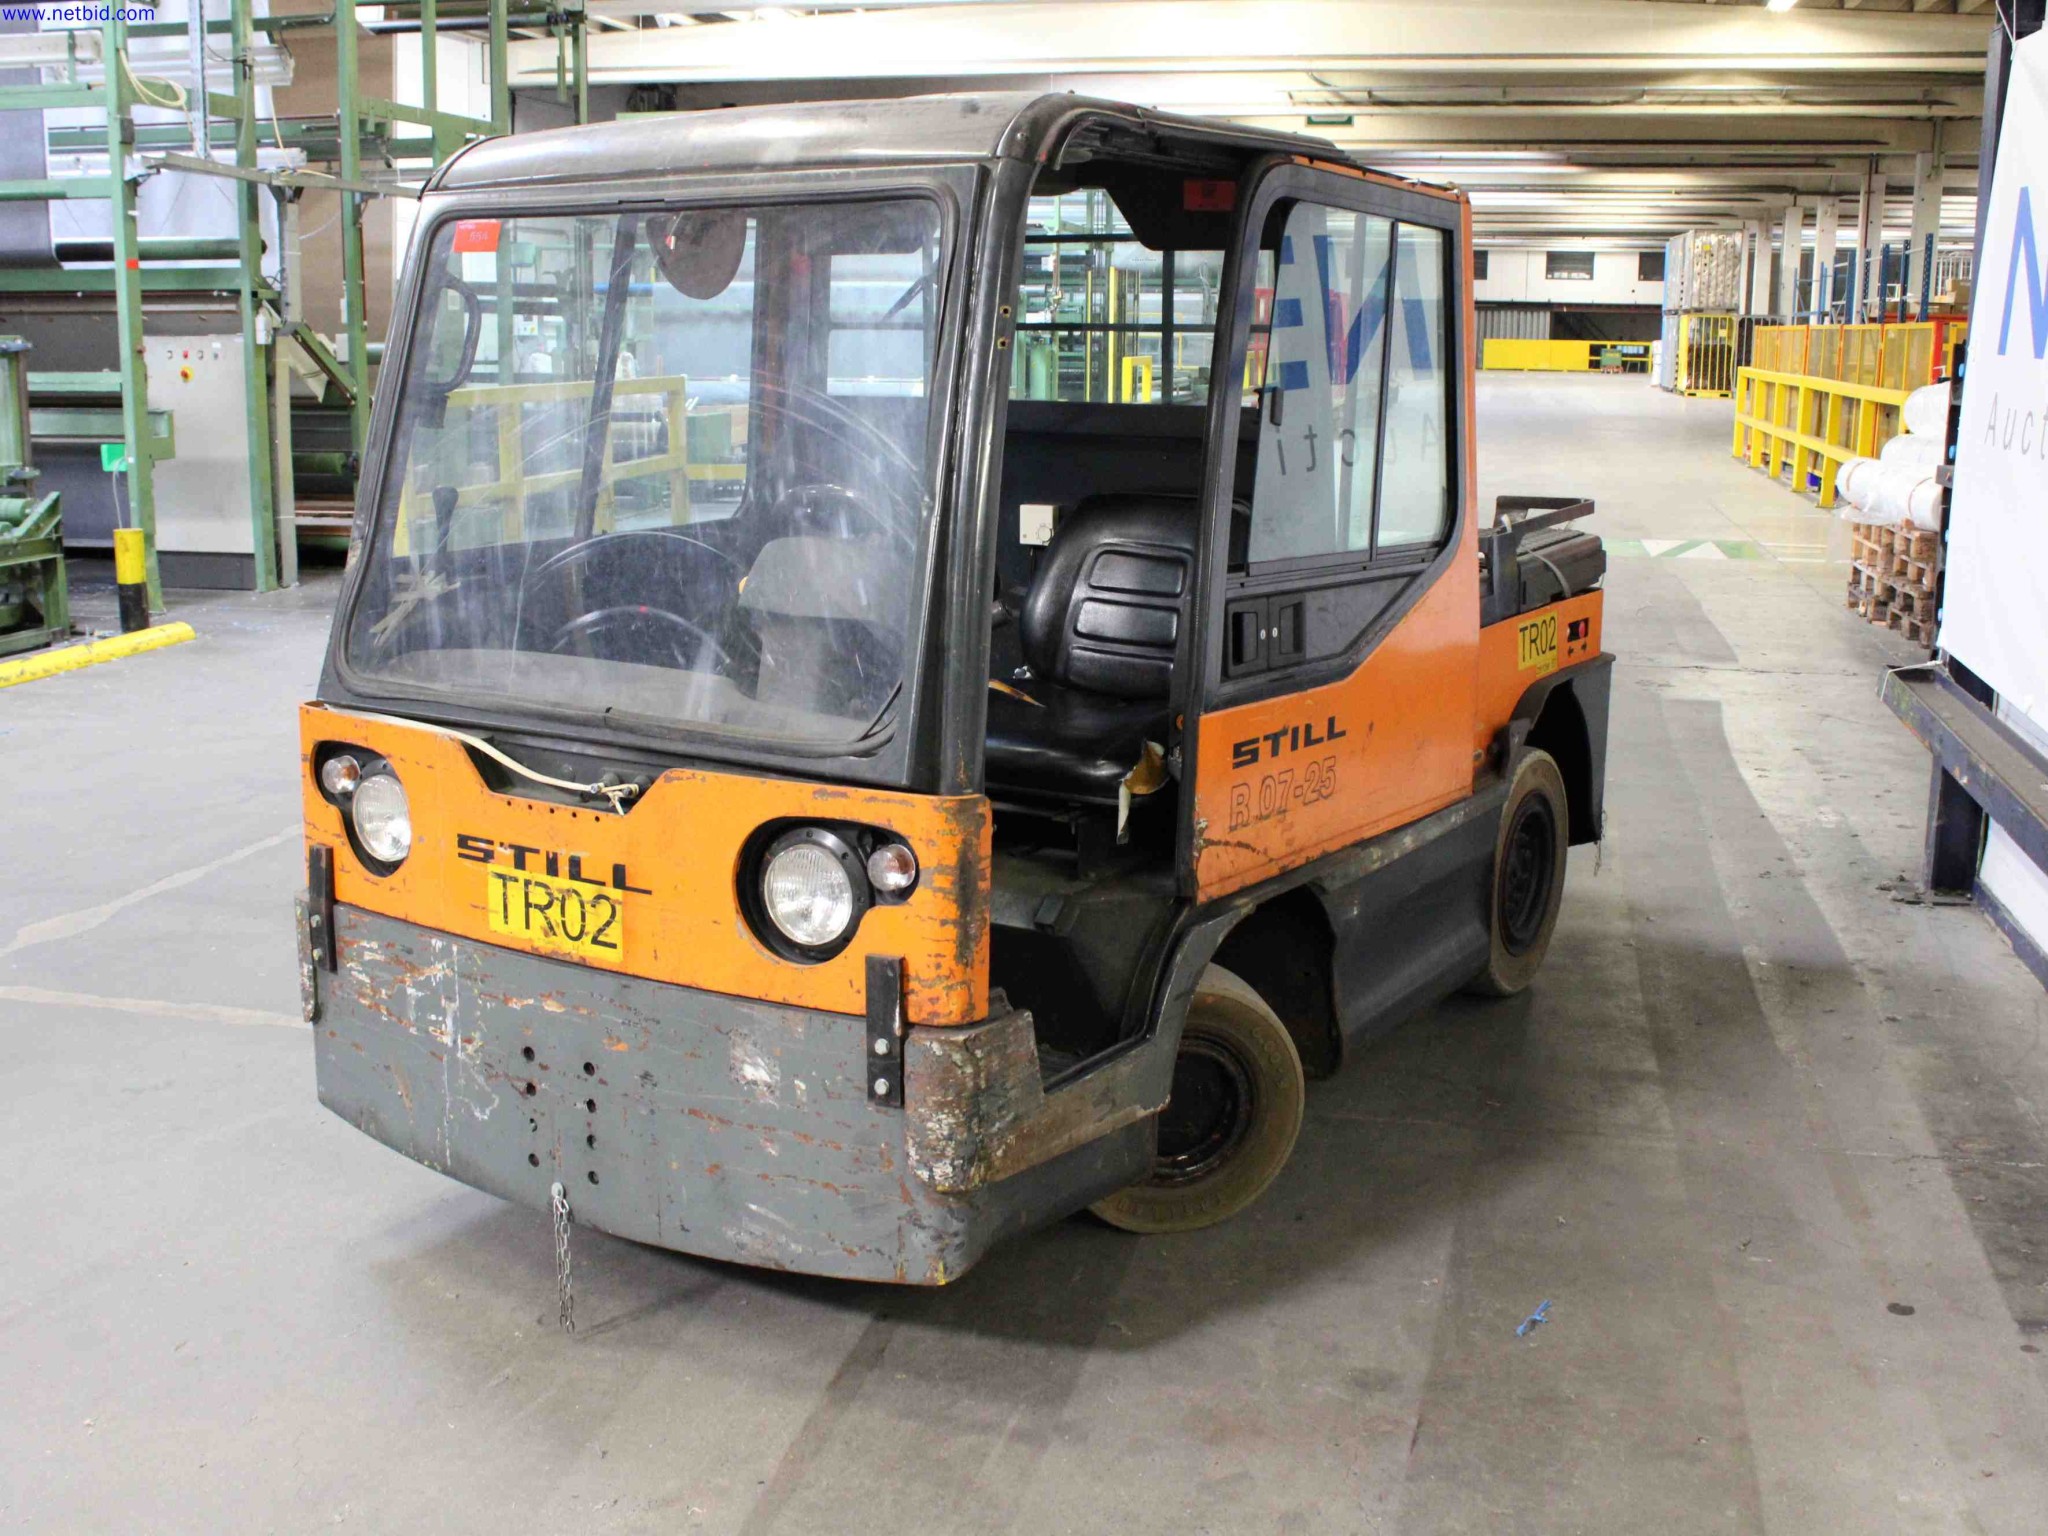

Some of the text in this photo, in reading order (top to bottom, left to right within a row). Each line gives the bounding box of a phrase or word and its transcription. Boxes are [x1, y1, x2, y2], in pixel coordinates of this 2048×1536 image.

[1519, 615, 1557, 663] TR02
[1232, 715, 1347, 770] STILL
[456, 833, 652, 895] STILL
[491, 871, 618, 949] TR02
